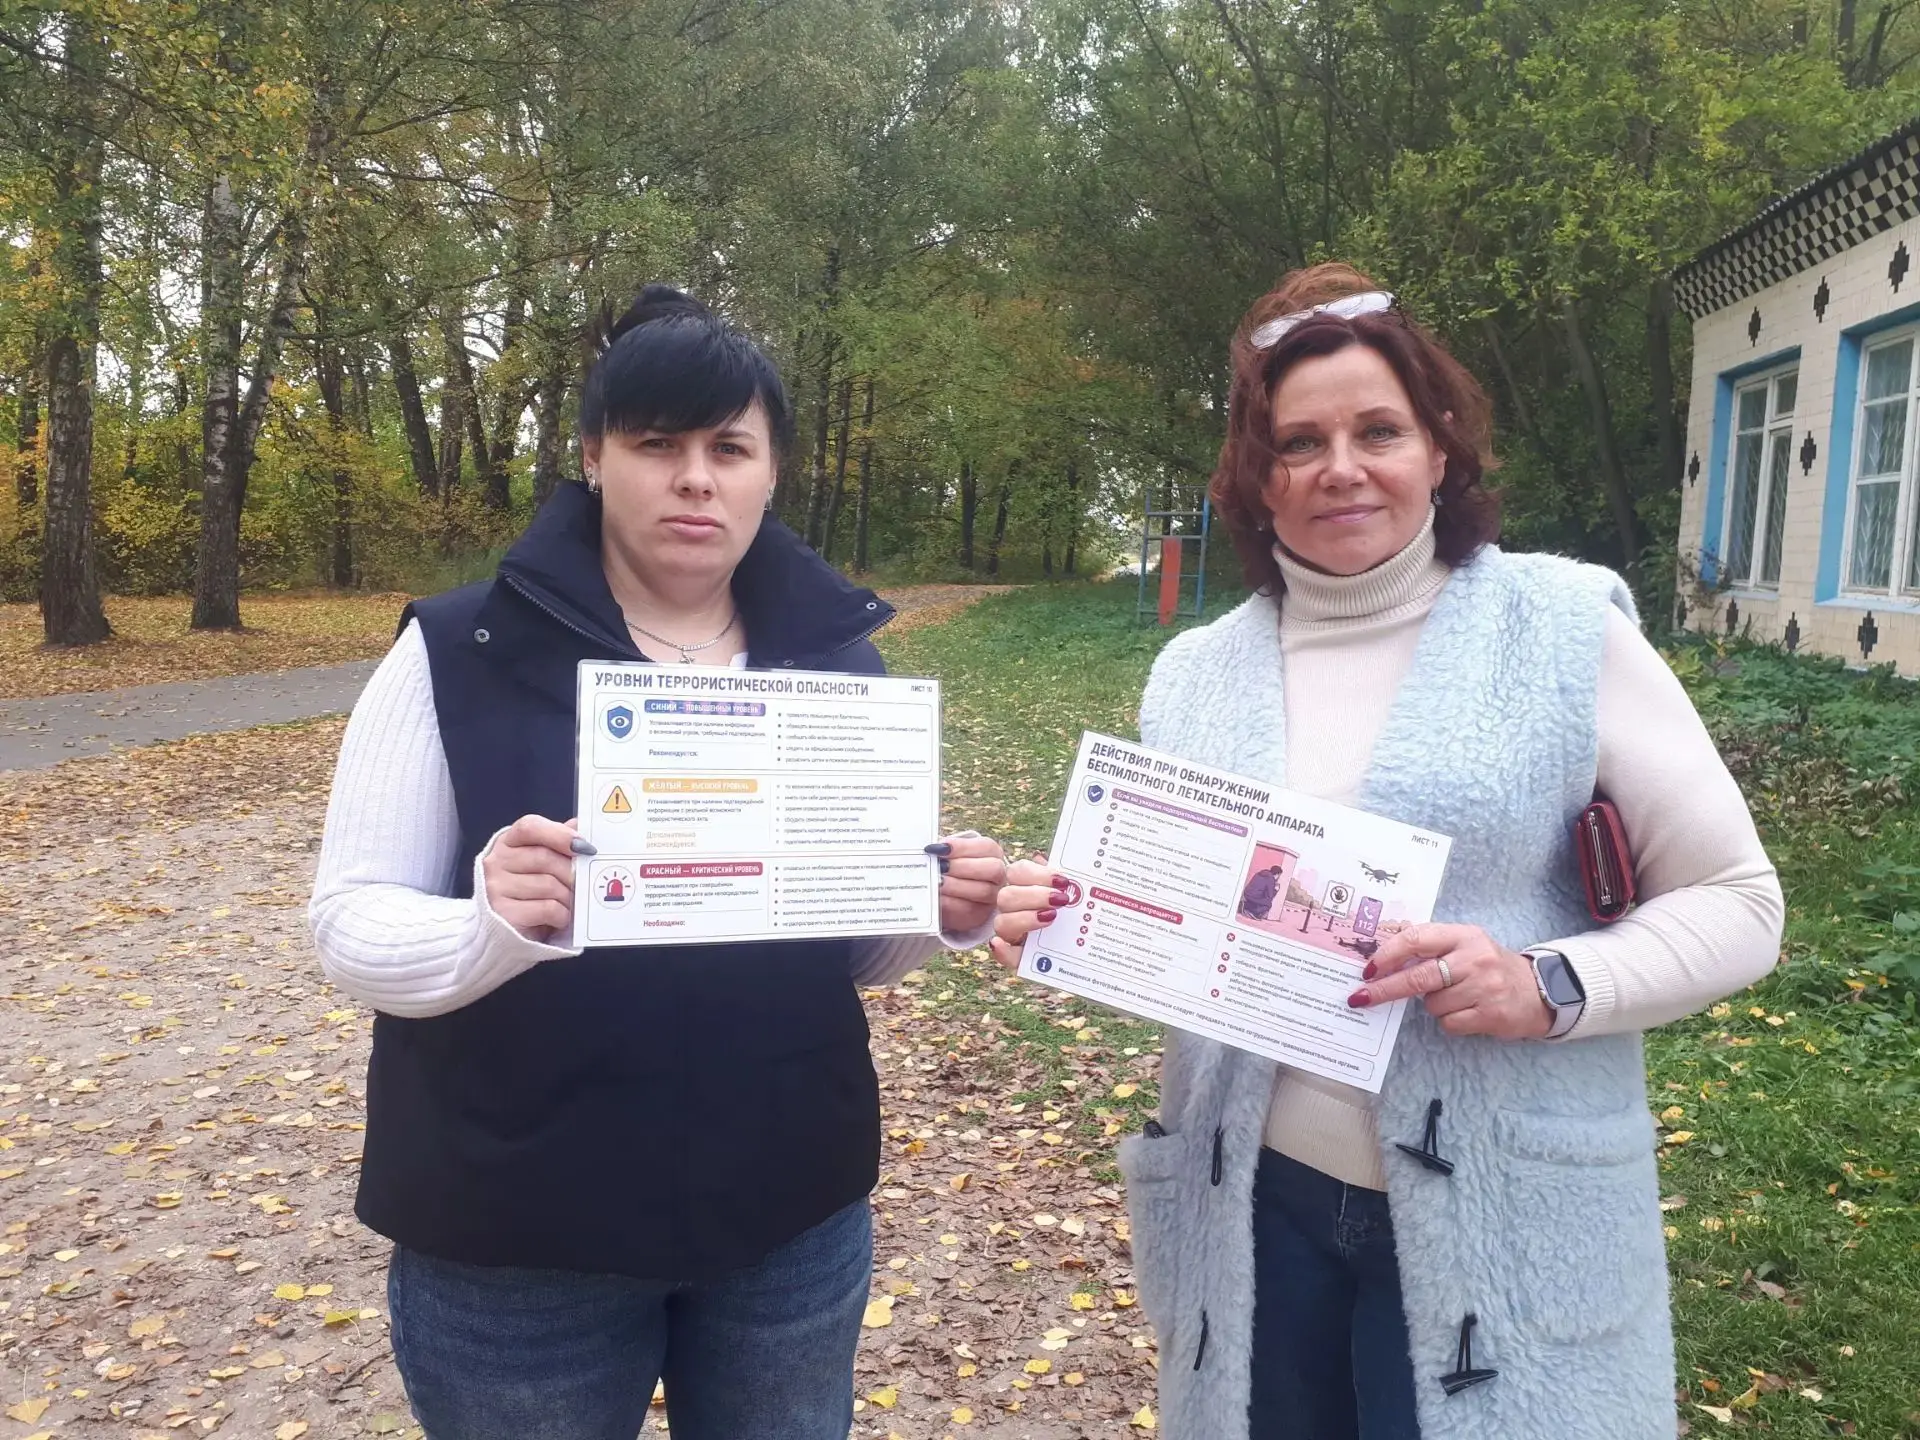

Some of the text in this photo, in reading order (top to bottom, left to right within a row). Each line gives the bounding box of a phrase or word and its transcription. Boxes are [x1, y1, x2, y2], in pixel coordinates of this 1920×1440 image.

[595, 672, 869, 696] УРОВНИ ТЕРРОРИСТИЧЕСКОЙ ОПАСНОСТИ
[650, 702, 677, 711] СИНИЙ
[1090, 740, 1270, 804] ДЕЙСТВИЯ ПРИ ОБНАРУЖЕНИИ
[1086, 757, 1326, 838] БЕСПИЛОТНОГО ЛЕТАТЕЛЬНОГО АППАРАТА
[1411, 834, 1438, 848] ЛИСТ 11
[646, 865, 759, 875] КРАСНЫЙ КРИТИЧЕСКИЙ УРОВЕНЬ
[1094, 889, 1139, 909] Категорически
[1356, 919, 1374, 931] 112
